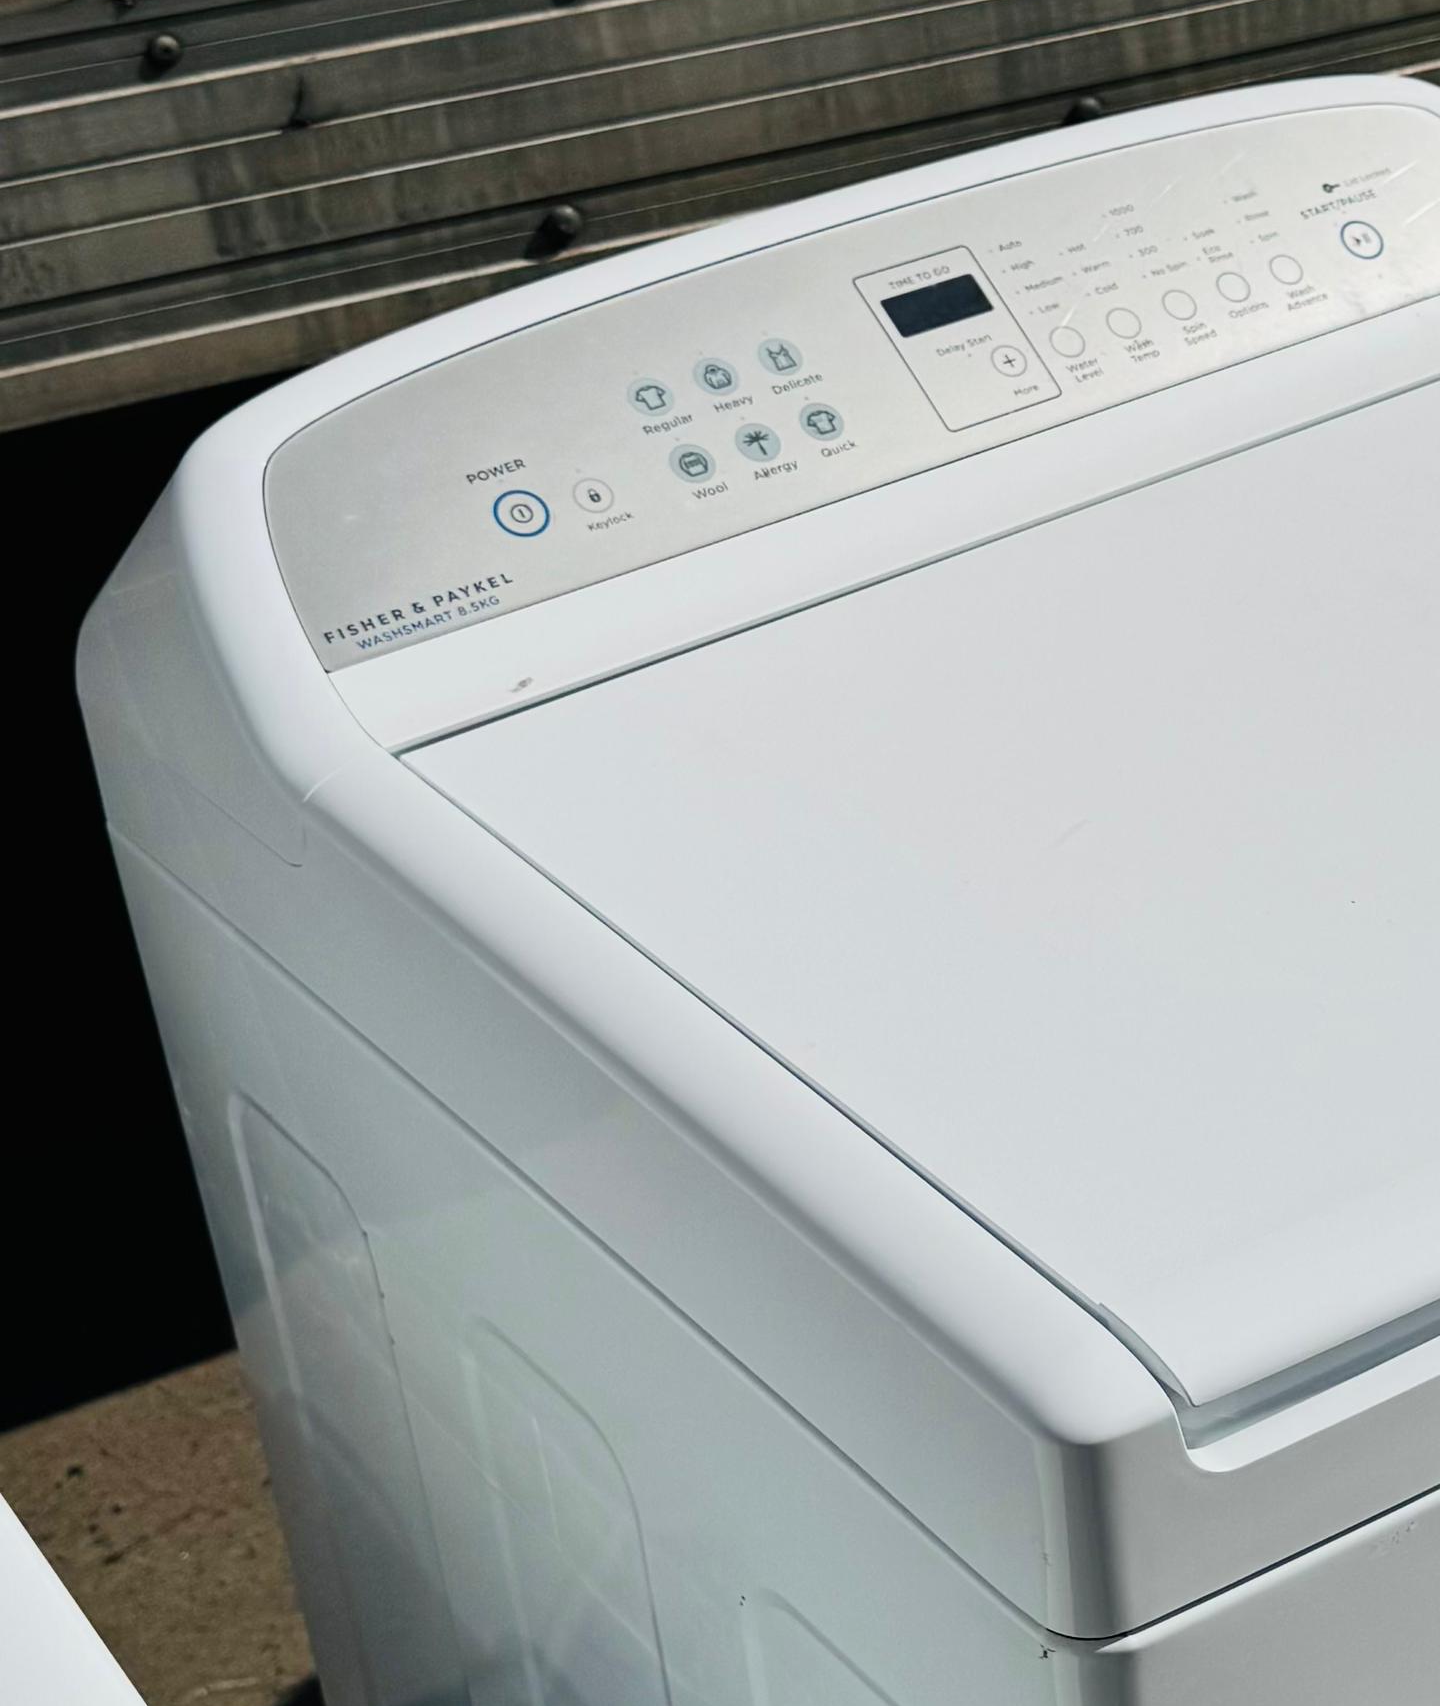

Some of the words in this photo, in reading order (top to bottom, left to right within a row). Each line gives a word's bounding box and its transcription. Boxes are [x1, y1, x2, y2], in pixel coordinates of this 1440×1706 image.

[1300, 189, 1376, 220] START/PAUSE
[888, 277, 914, 290] TIME
[915, 271, 932, 282] TO
[1228, 301, 1270, 319] Options
[771, 373, 823, 395] Delicate
[713, 395, 754, 413] Heavy
[642, 414, 693, 435] Regular
[820, 440, 857, 459] Quick
[466, 458, 526, 484] POWER
[754, 460, 799, 481] Allergy
[692, 481, 729, 500] Wool
[587, 511, 635, 532] Keylock
[323, 608, 405, 644] FISHER
[412, 601, 426, 614] &
[432, 573, 514, 607] PAYKEL
[356, 610, 453, 650] WASHSMART
[458, 595, 501, 617] 8.5KG
